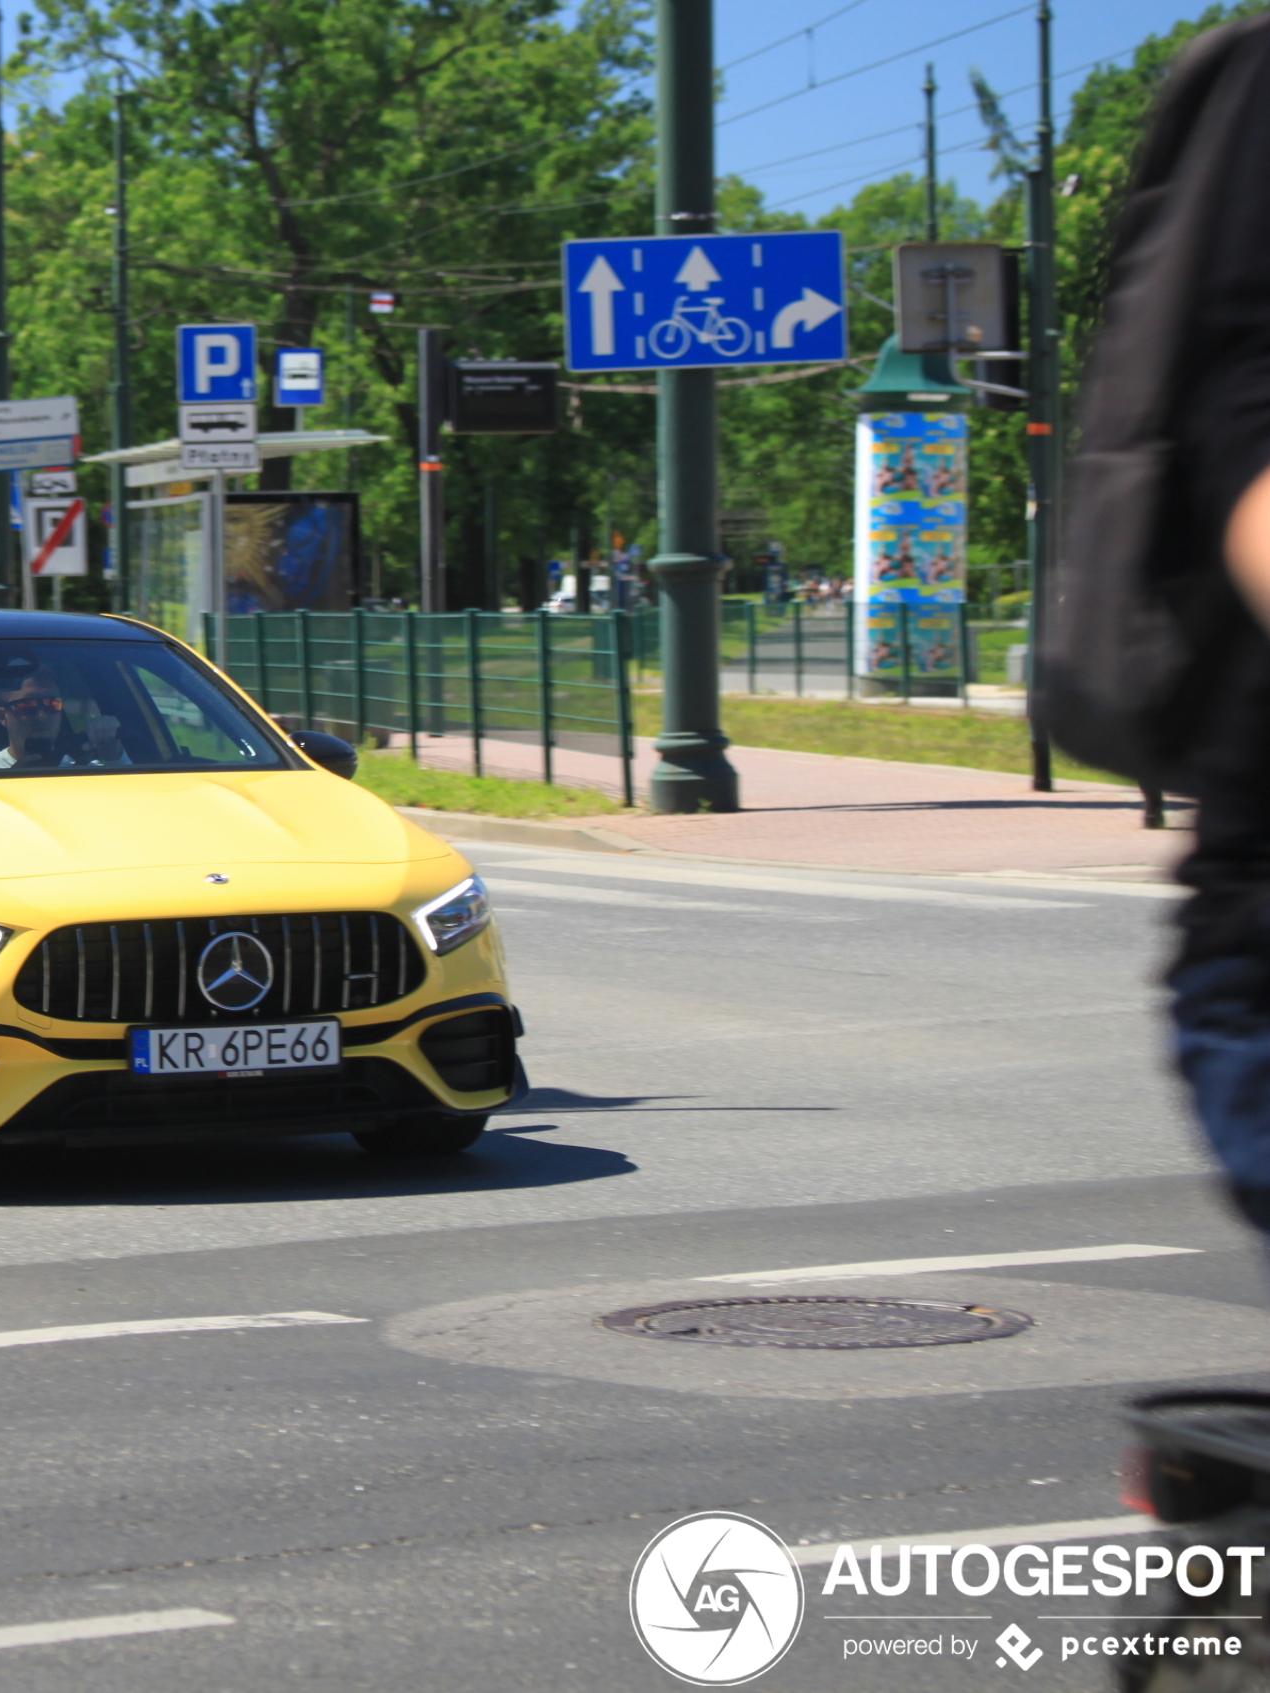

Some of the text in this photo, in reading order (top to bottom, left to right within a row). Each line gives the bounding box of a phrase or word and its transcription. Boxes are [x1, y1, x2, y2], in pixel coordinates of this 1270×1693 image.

[194, 333, 241, 395] P
[134, 1057, 149, 1068] PL
[157, 1026, 329, 1069] KR 6PE66
